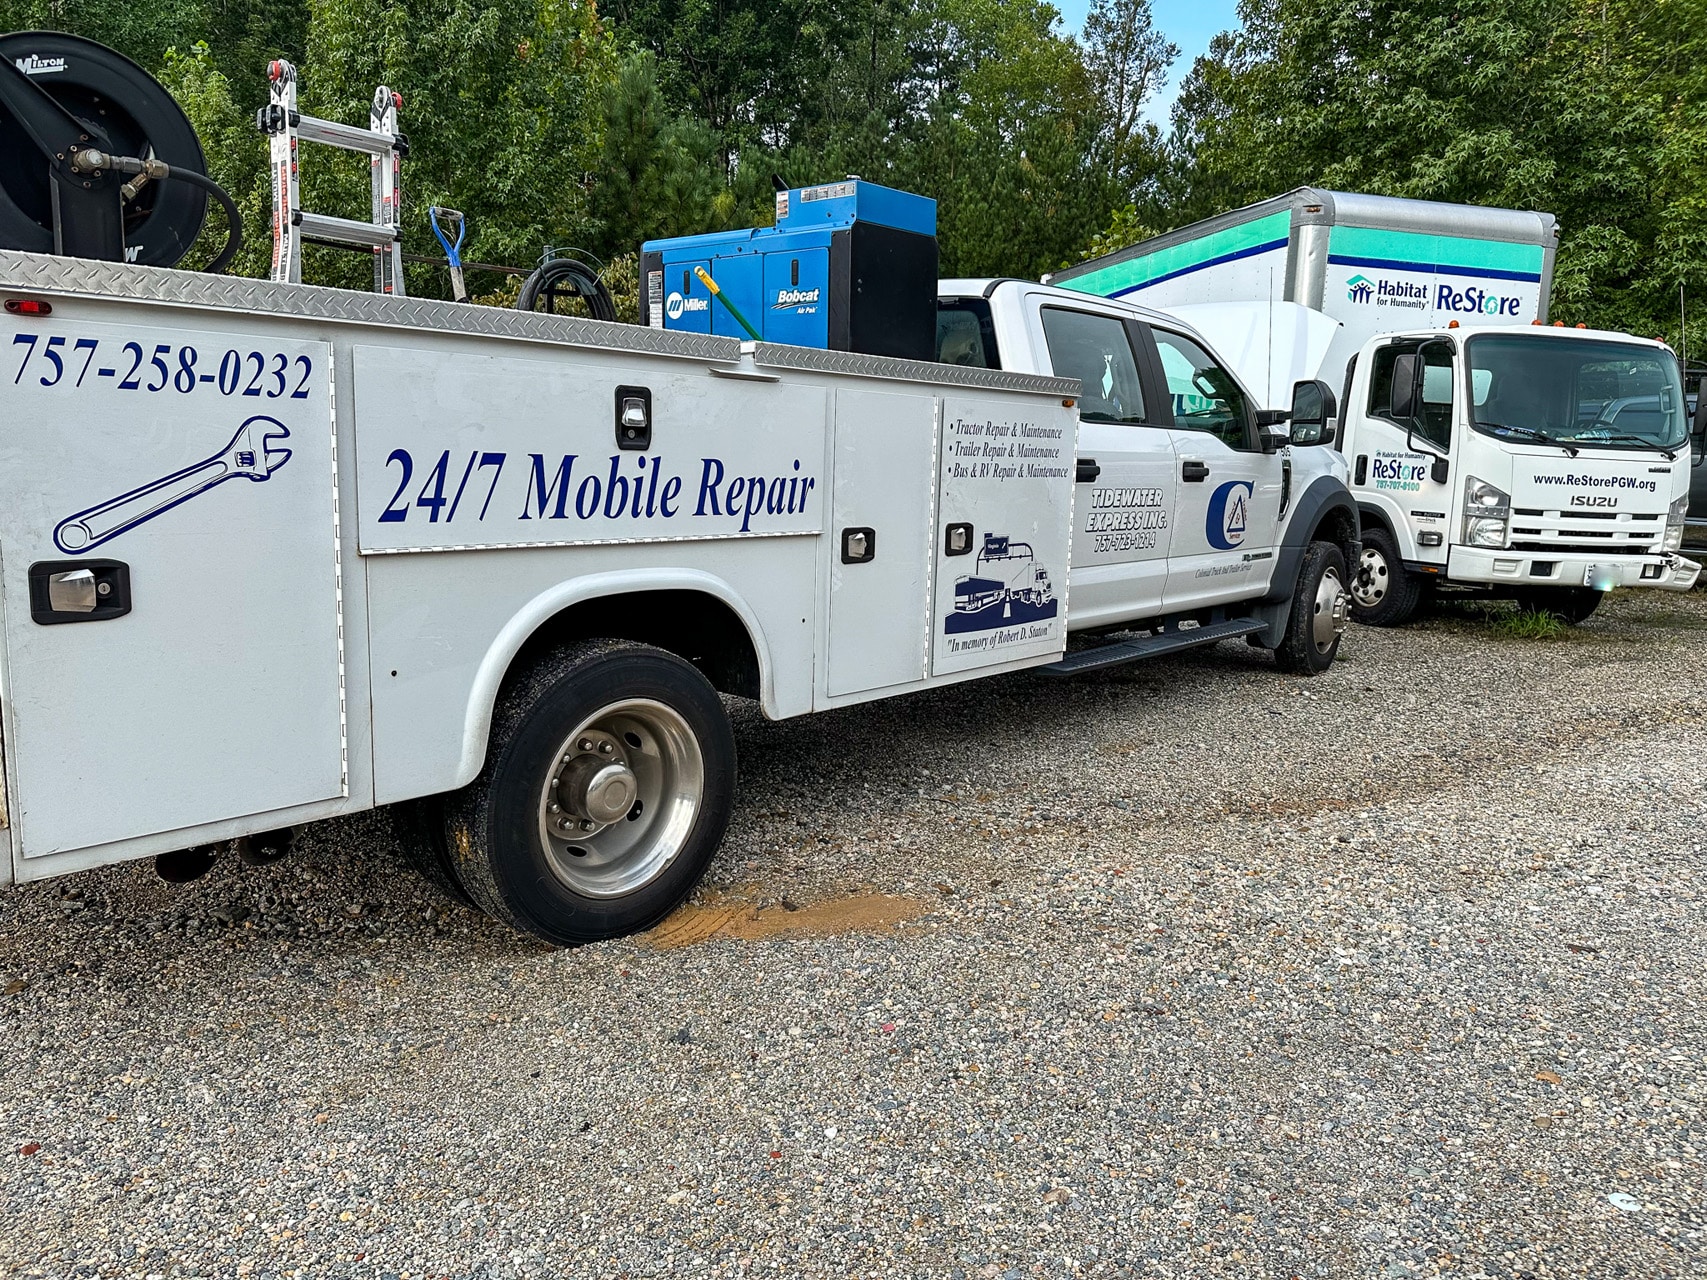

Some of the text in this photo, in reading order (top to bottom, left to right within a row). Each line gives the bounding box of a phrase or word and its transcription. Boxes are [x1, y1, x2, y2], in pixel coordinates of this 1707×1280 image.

[778, 288, 820, 303] Bobcat
[1377, 280, 1428, 299] Habitat
[684, 298, 708, 311] Miller
[1376, 296, 1427, 311] for Humanity
[1436, 284, 1521, 316] ReStore
[12, 333, 313, 399] 757-258-0232
[955, 419, 1063, 440] Tractor Repair & Maintenance
[954, 441, 1060, 461] Trailer Repair & Maintenance
[953, 463, 1069, 482] Bus & RV Repair & Maintenance
[1372, 458, 1426, 481] ReStore
[378, 448, 815, 532] 24/7 Mobile Repair
[1533, 474, 1656, 492] www.ReStorePGW.org
[1092, 488, 1163, 508] TIDEWATER
[1570, 495, 1618, 508] ISUZU
[1085, 510, 1167, 532] EXPRESS INC.
[1094, 531, 1156, 552] 757-723-1214
[961, 635, 988, 650] memory
[989, 631, 999, 648] of
[998, 630, 1020, 644] Robert
[1020, 627, 1028, 640] D.
